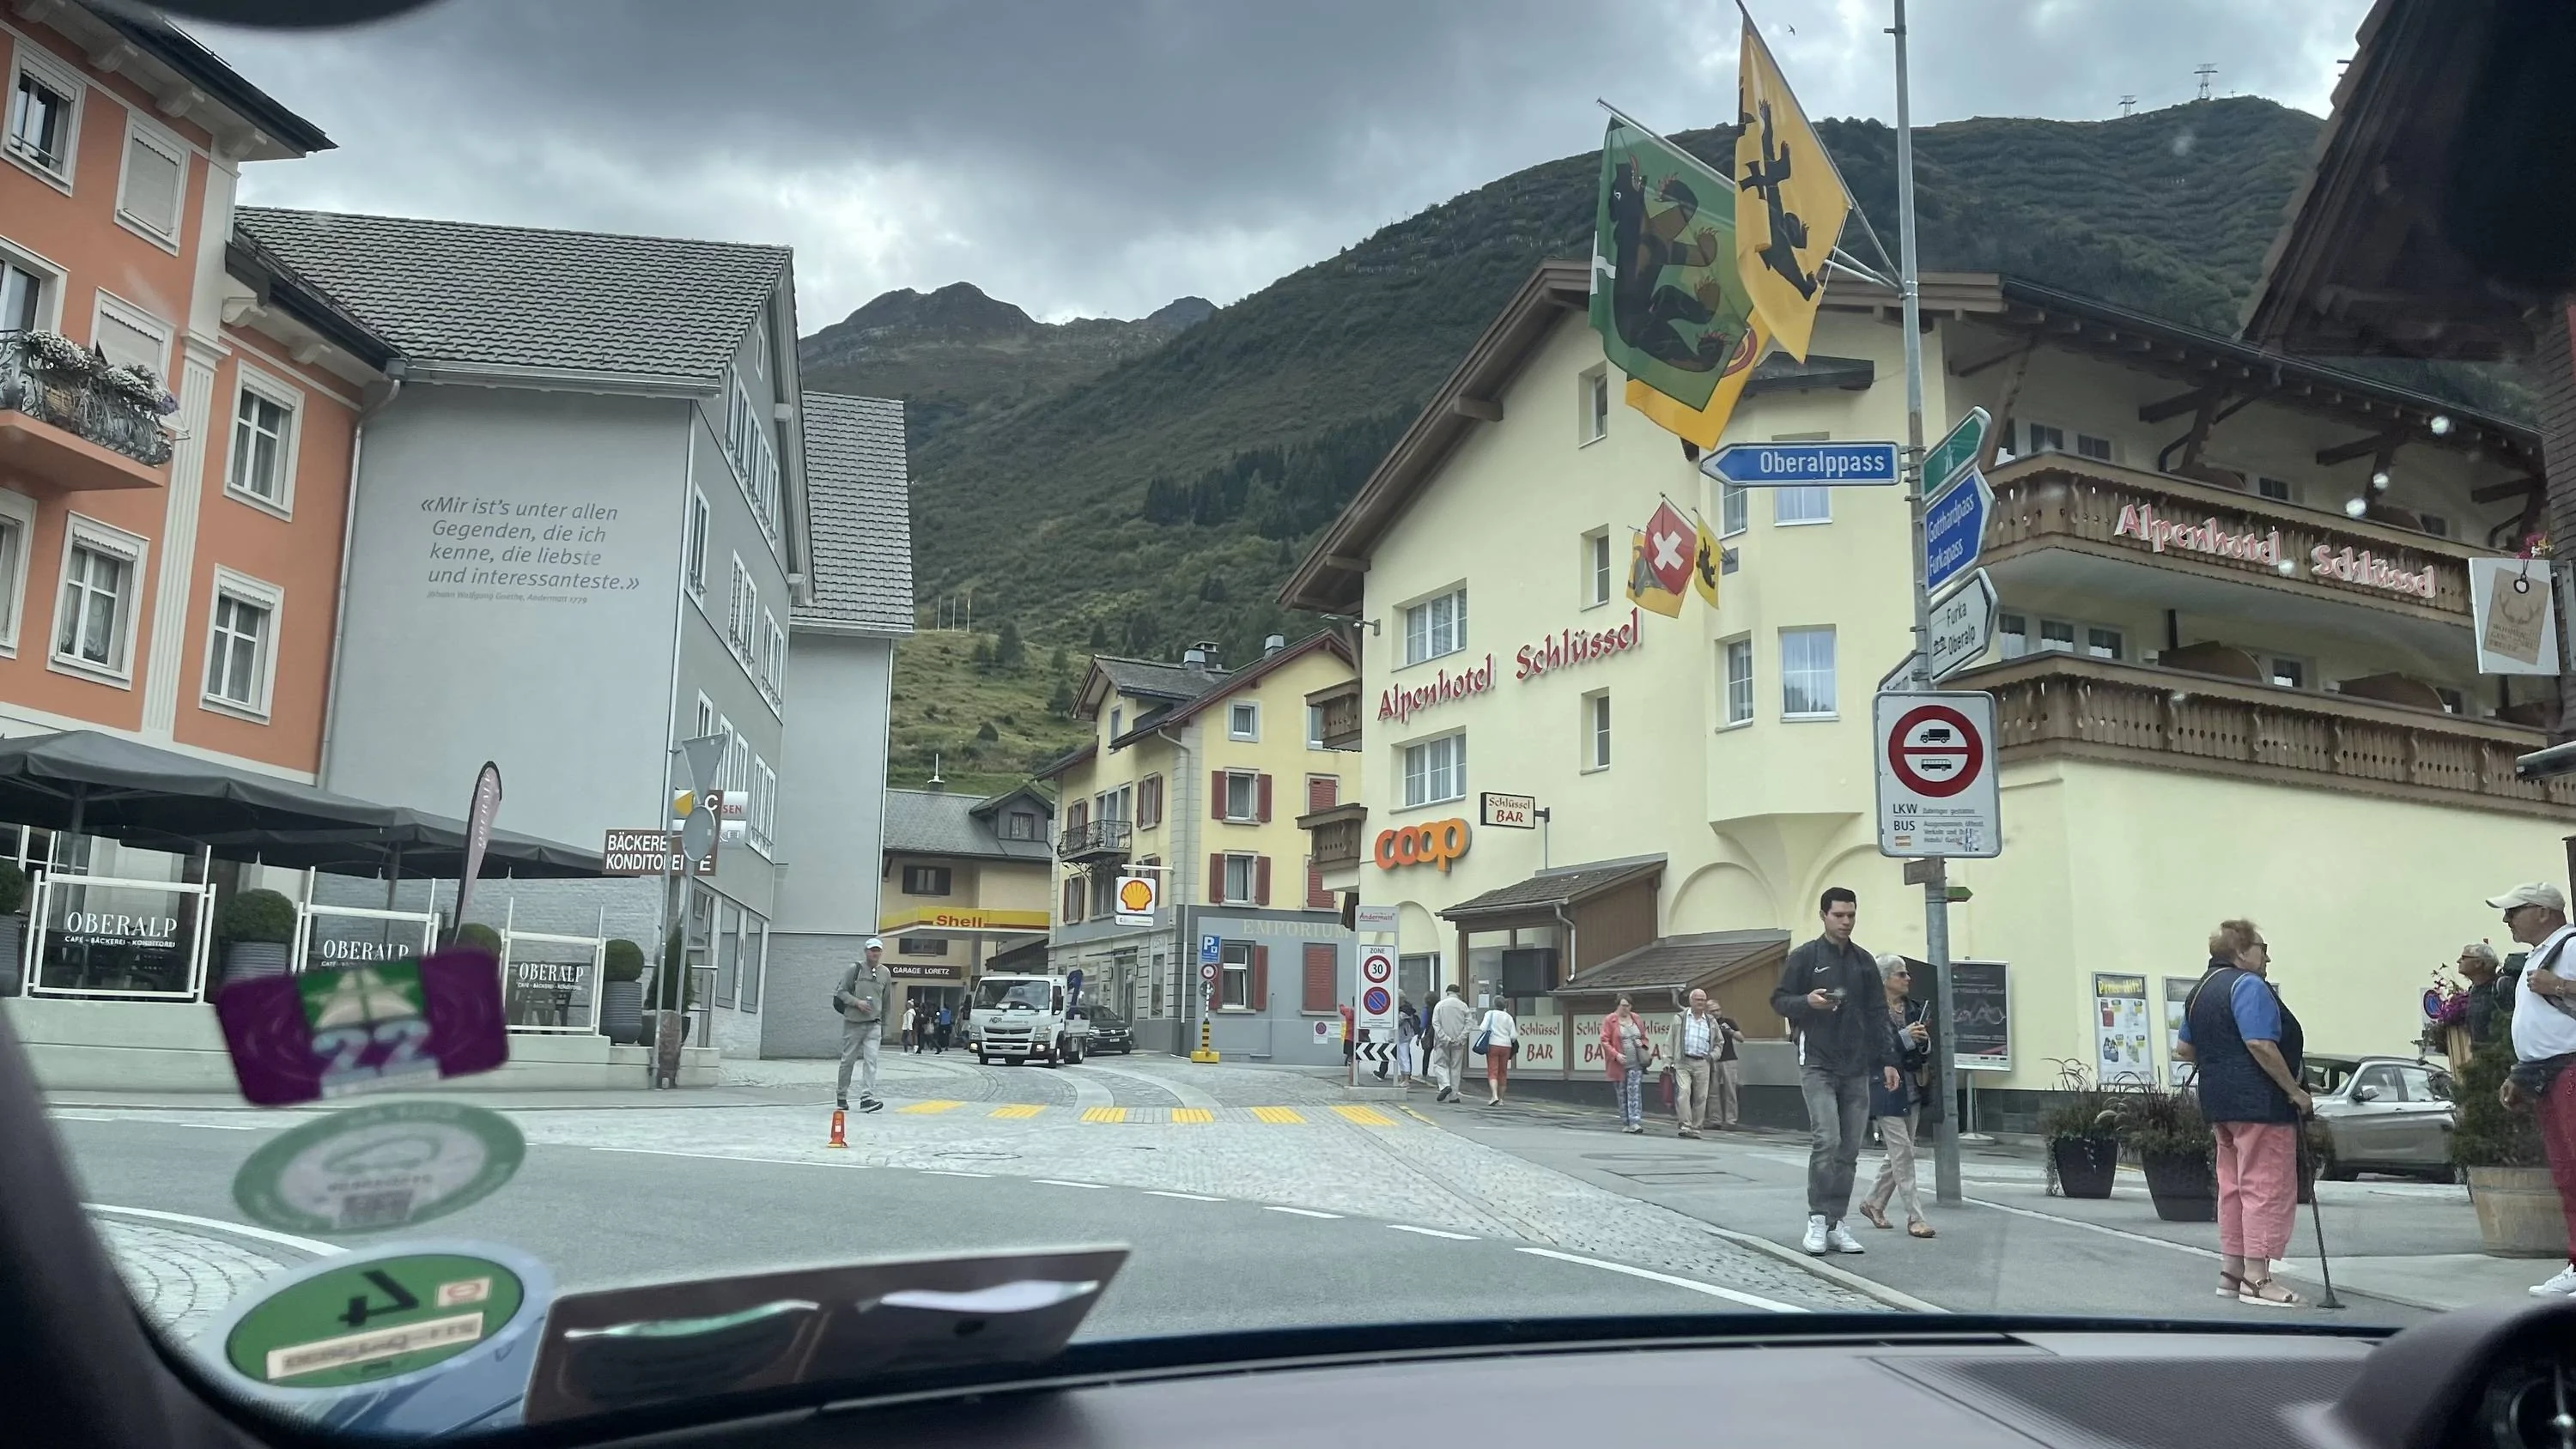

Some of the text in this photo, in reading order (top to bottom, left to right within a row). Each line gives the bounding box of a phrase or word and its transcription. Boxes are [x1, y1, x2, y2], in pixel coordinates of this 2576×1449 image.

[1760, 451, 1886, 478] Oberalppass
[515, 503, 568, 519] unter
[571, 503, 618, 521] allen
[1928, 494, 1974, 543] Gotthardpass
[432, 519, 606, 543] Gegenden, die ich
[2114, 503, 2281, 567] Alpenhotel
[429, 543, 602, 566] kenne, die liebste
[1929, 537, 1964, 578] Furkapass
[428, 567, 467, 584] und
[1947, 601, 1967, 627] Furka
[1947, 624, 1976, 656] Oberalp
[1377, 608, 1642, 724] Alpenhotel Schlüssel
[1489, 797, 1530, 809] Schlüssel
[1893, 803, 1917, 814] LKW
[1496, 809, 1523, 822] BAR
[1893, 821, 1916, 831] BUS
[608, 832, 667, 852] BÄCKERE
[1375, 817, 1472, 872] coop
[67, 912, 178, 938] OBERALP
[936, 914, 983, 928] Shell
[1243, 920, 1351, 939] EMPORIUM
[323, 939, 409, 961] OBERALP
[519, 962, 584, 983] OBERALP
[1372, 964, 1383, 974] 30
[1520, 1022, 1559, 1036] Schlüssel
[312, 1020, 430, 1088] 22
[1527, 1043, 1553, 1061] BAR
[1584, 1043, 1604, 1063] BA
